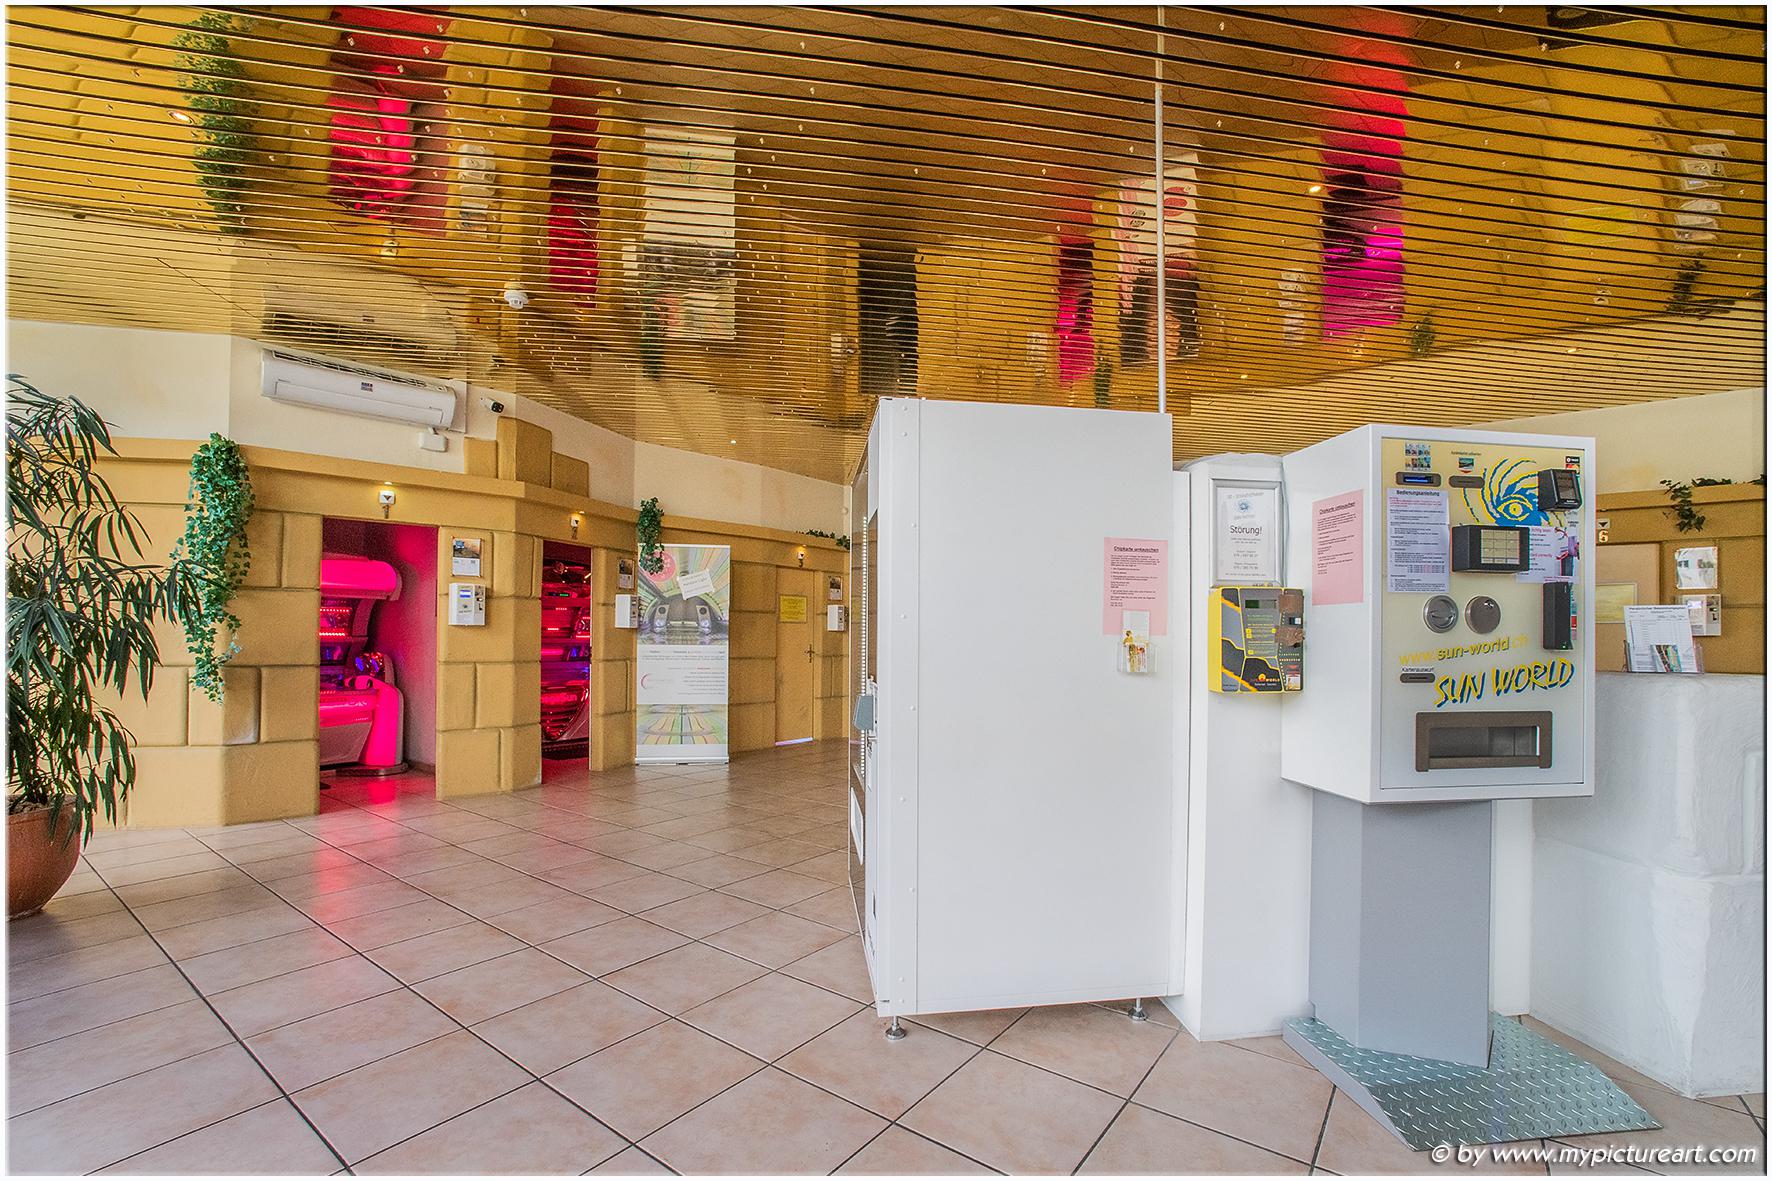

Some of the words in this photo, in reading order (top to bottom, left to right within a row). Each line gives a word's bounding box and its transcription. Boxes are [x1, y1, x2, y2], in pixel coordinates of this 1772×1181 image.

[1230, 525, 1262, 536] Störung!
[1599, 530, 1608, 543] 6
[1399, 634, 1529, 665] www.sun-world.ch
[1434, 671, 1485, 708] SUN
[1492, 657, 1574, 697] WORLD
